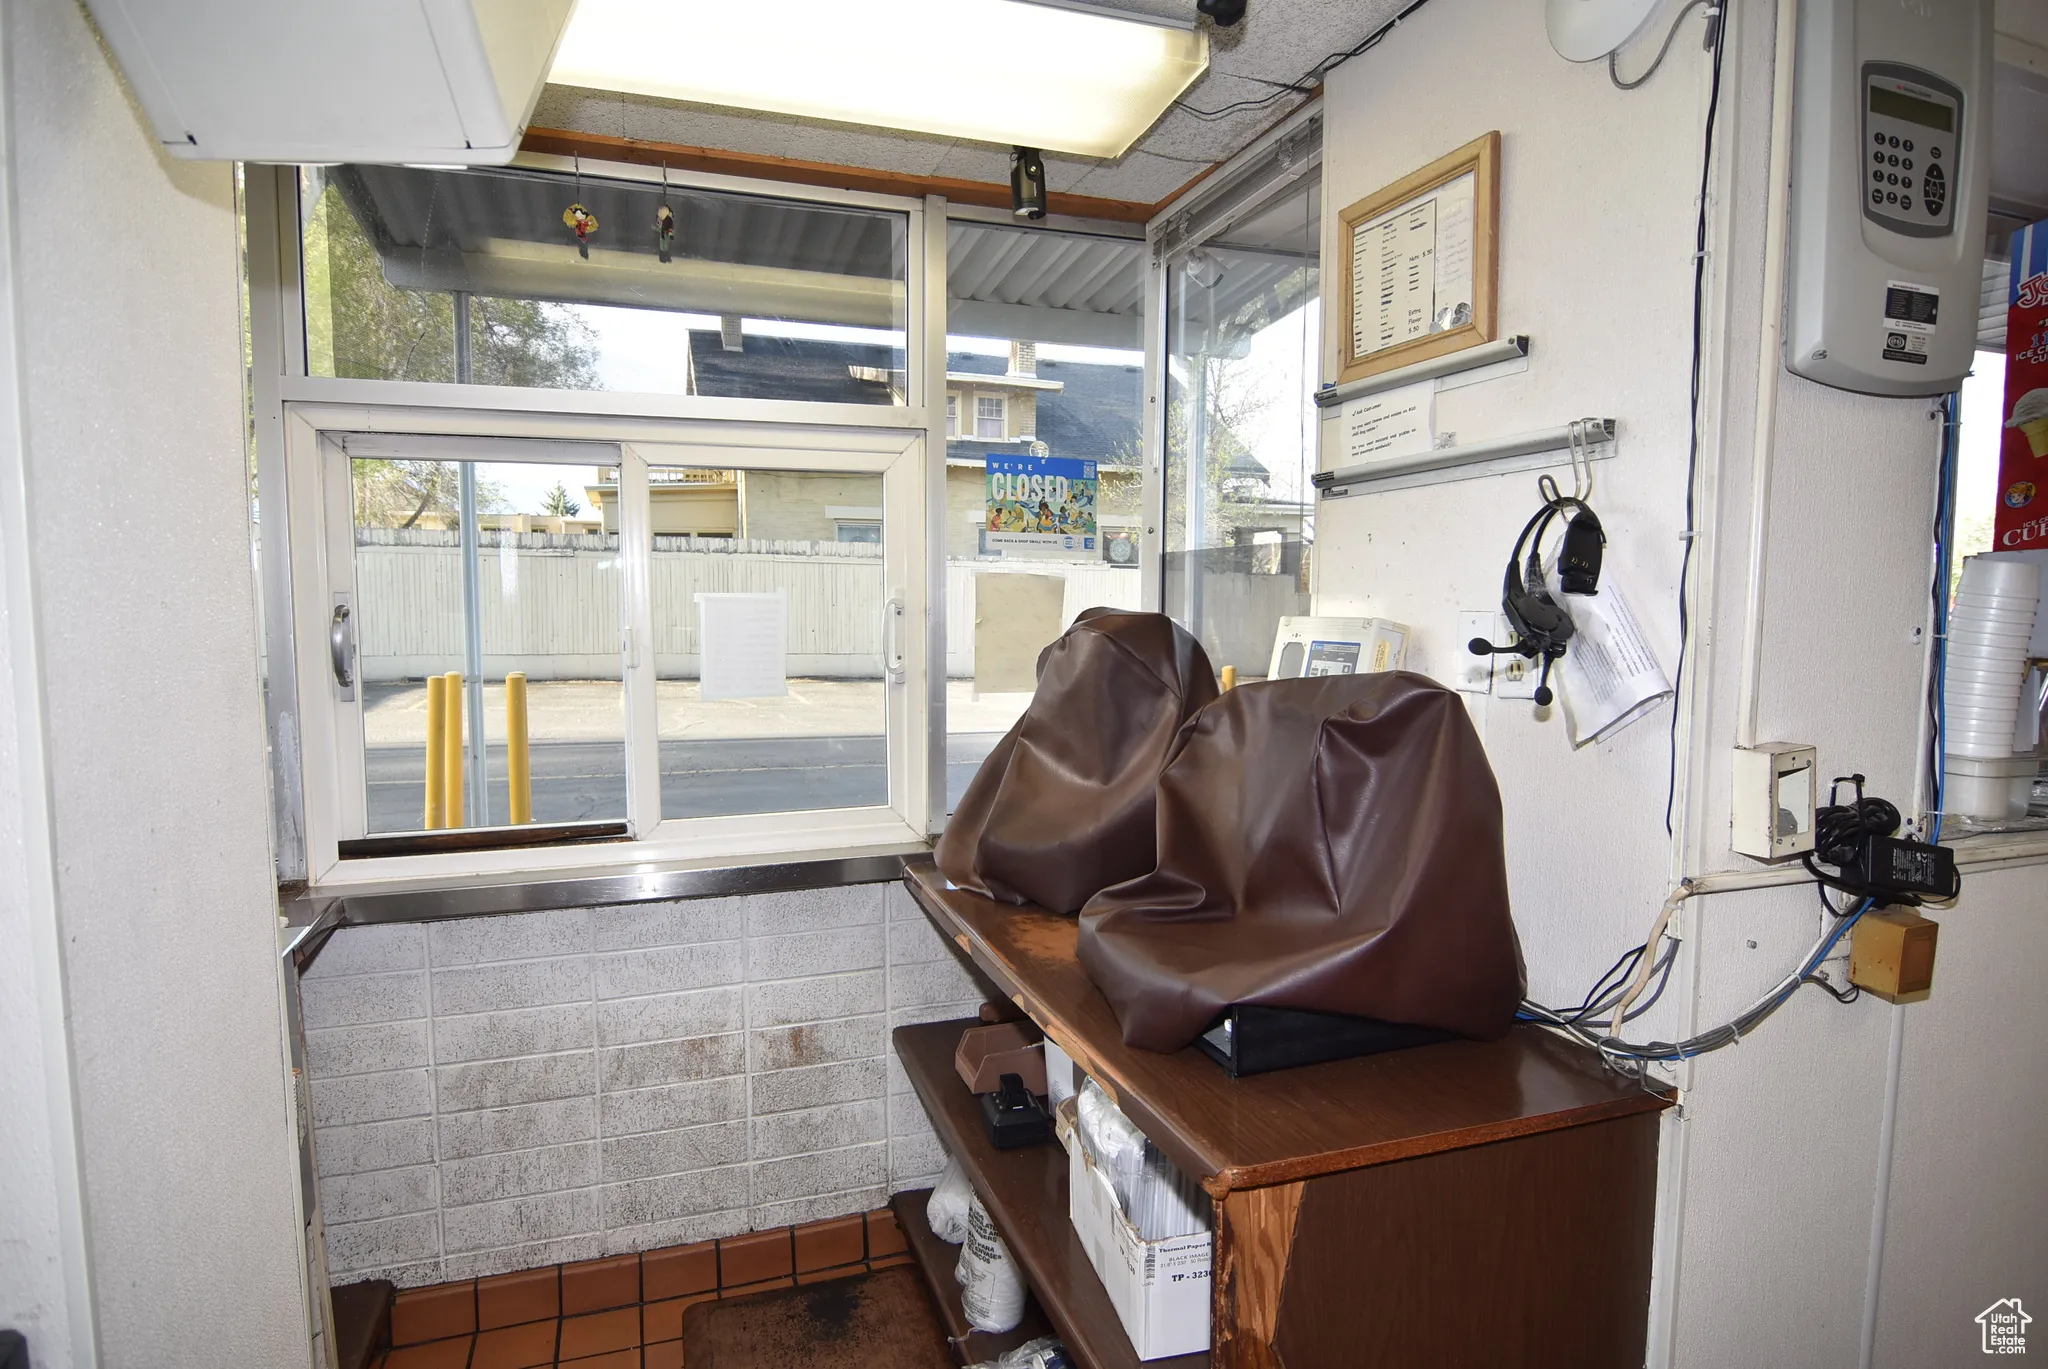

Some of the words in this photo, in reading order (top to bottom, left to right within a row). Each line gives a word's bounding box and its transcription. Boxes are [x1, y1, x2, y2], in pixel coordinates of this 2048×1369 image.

[1408, 308, 1421, 317] Extra
[2016, 349, 2034, 361] ICE
[992, 462, 1032, 471] WE'RE
[992, 472, 1068, 503] CLOSED
[2022, 519, 2037, 528] ICE
[1169, 1255, 1188, 1263] BLACK
[1172, 1273, 1185, 1283] TP
